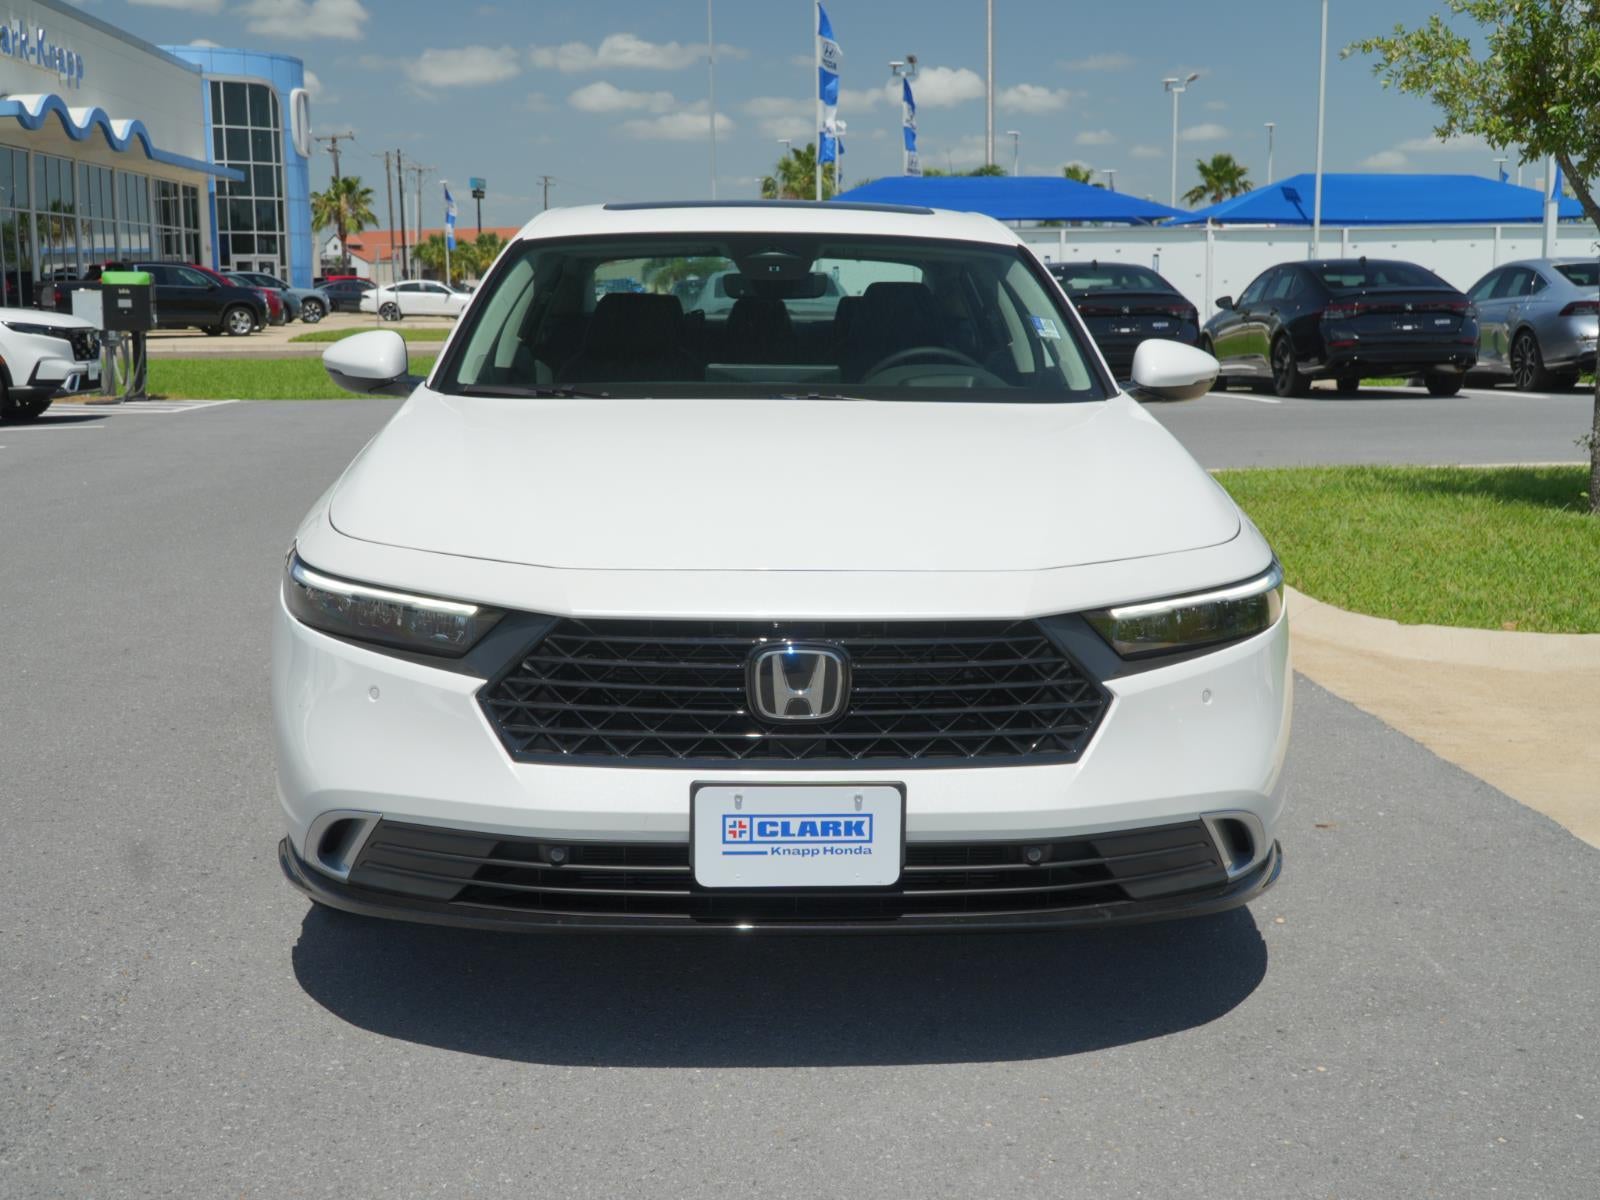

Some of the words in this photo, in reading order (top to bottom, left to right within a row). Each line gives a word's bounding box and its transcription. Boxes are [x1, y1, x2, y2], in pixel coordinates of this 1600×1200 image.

[757, 820, 866, 837] CLARK
[771, 846, 820, 857] Knapp
[823, 846, 872, 855] Honda
